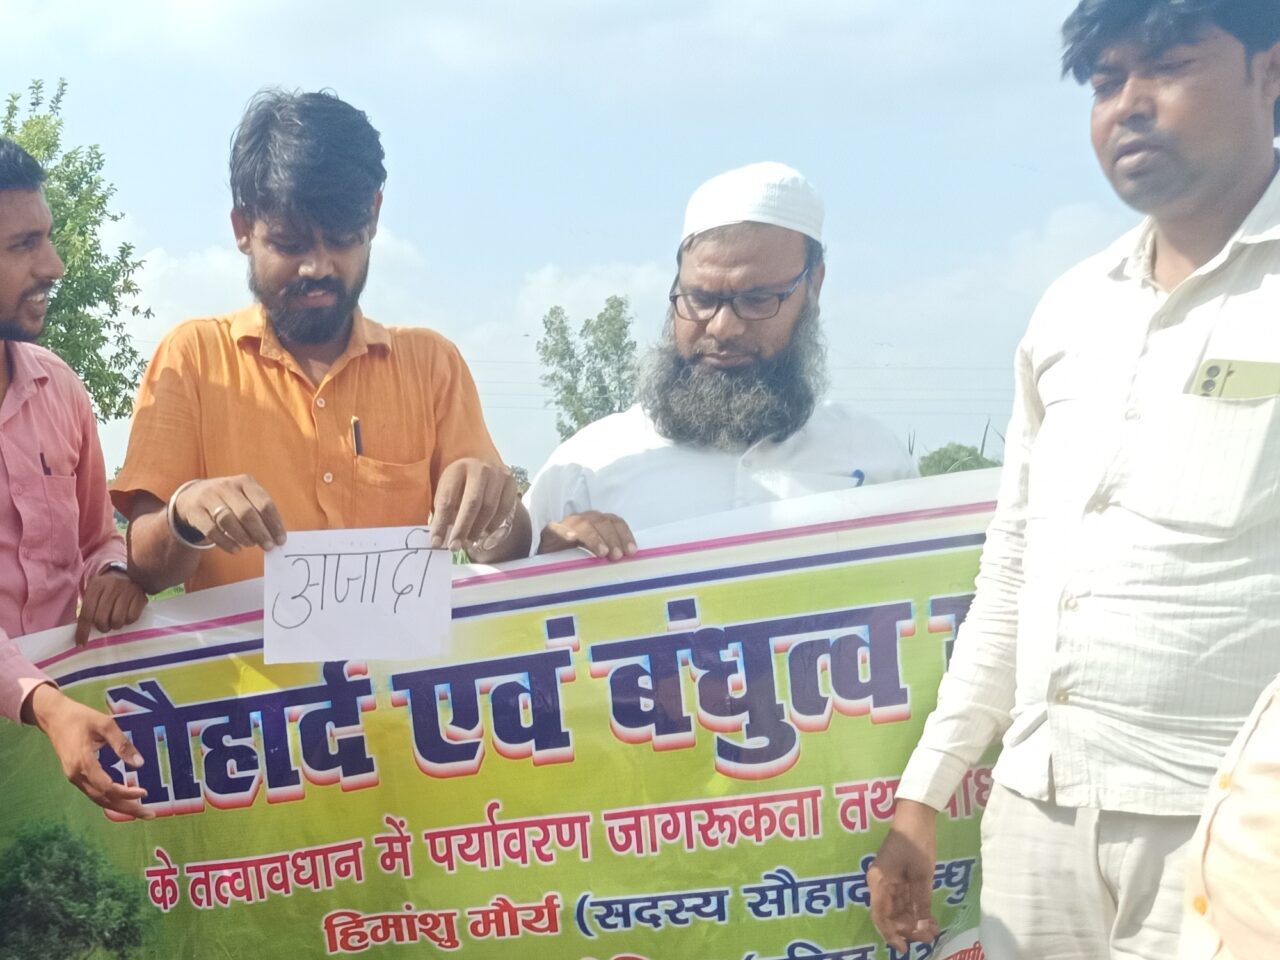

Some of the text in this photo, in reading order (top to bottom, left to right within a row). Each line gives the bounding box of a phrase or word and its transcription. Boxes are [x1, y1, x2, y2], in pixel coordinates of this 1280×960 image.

[391, 614, 577, 779] एवं
[591, 598, 915, 780] बंधुत्व
[147, 849, 179, 911] के
[186, 837, 364, 909] तत्वावधान
[374, 816, 413, 878] में
[424, 801, 592, 873] पर्यावरण
[604, 788, 822, 857] जागरूकता
[323, 904, 459, 952] हिमांशु
[468, 895, 560, 938] मौर्य
[576, 889, 730, 937] (सदस्य
